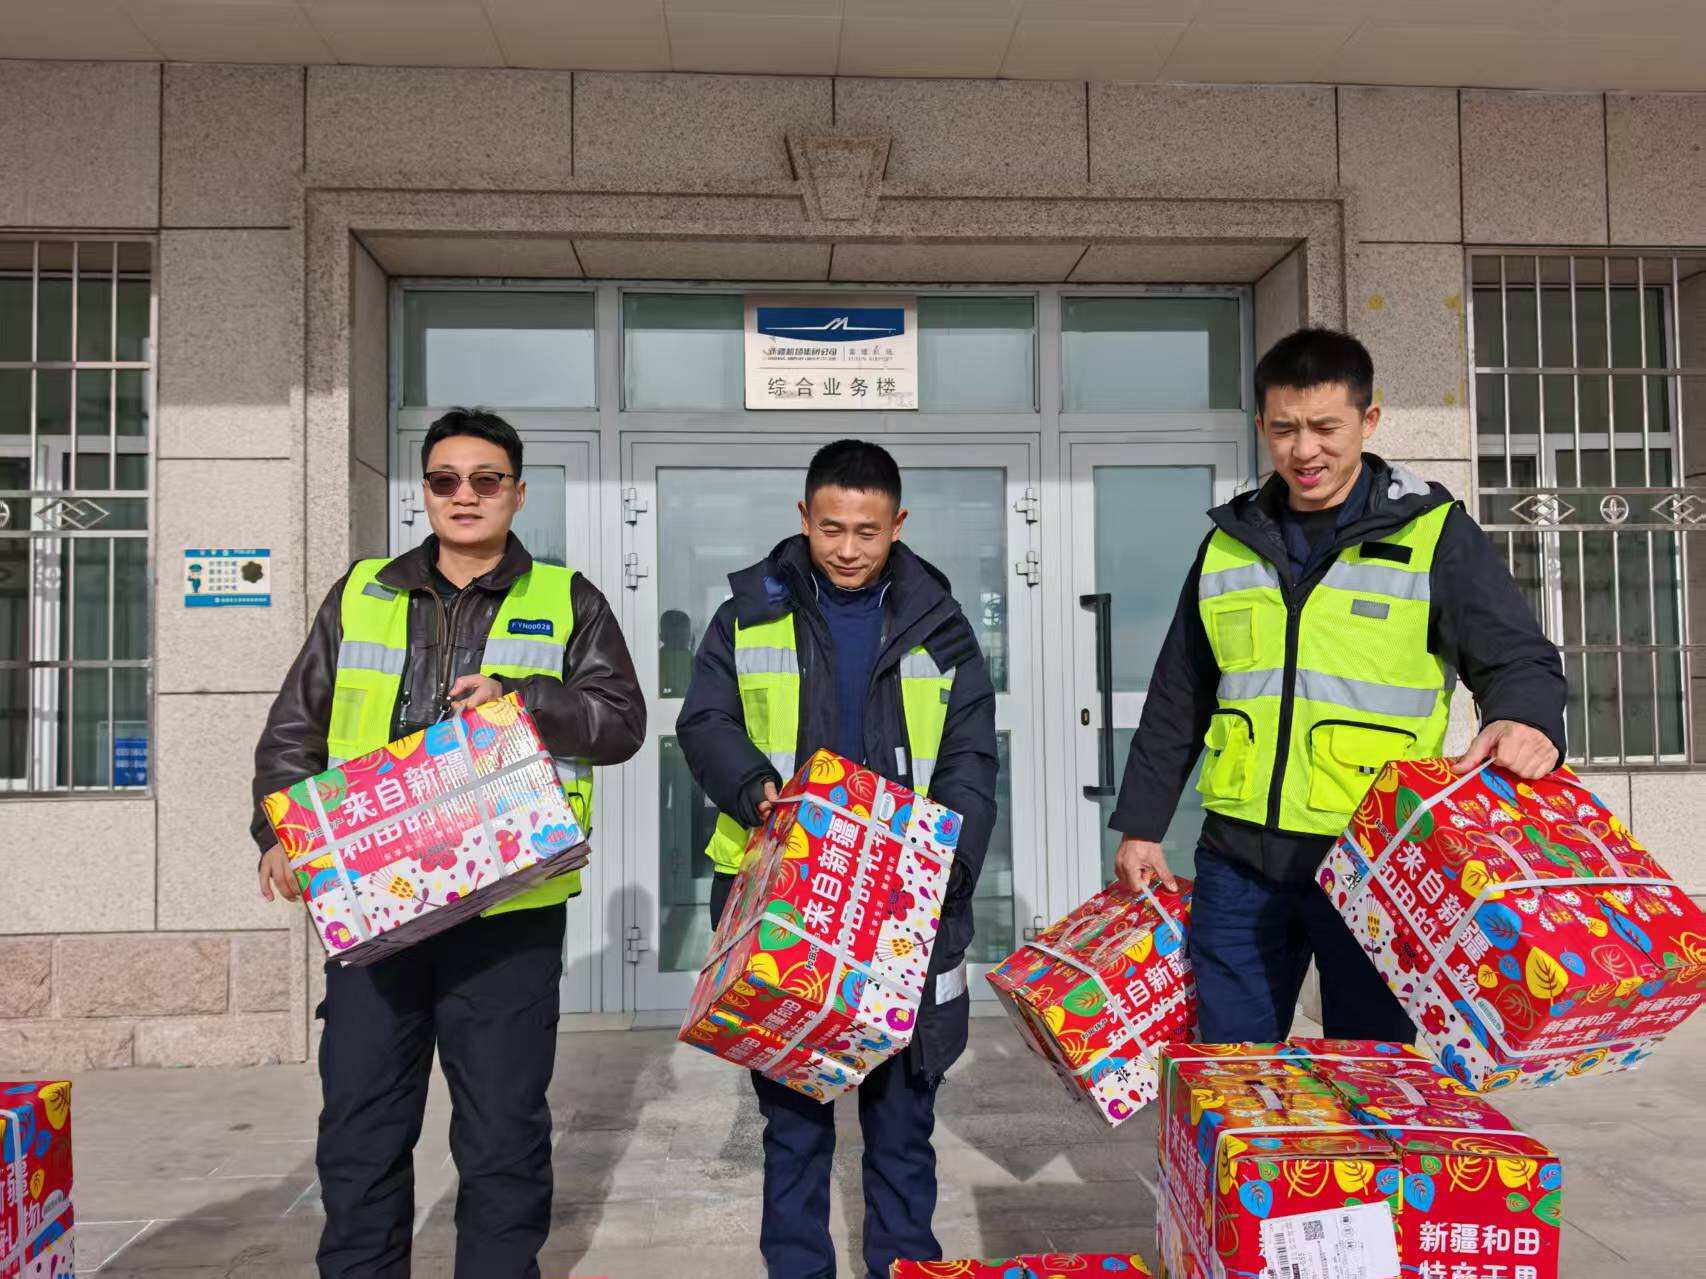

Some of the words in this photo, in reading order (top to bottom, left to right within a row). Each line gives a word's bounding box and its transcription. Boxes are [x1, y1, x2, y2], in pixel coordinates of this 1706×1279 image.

[768, 377, 896, 398] 综合业务楼
[342, 751, 470, 827] 来自新疆
[802, 813, 861, 935] 来自新疆
[1397, 841, 1493, 967] 来自新疆
[1103, 948, 1192, 1024] 来自新疆
[1419, 1221, 1540, 1255] 新疆和田
